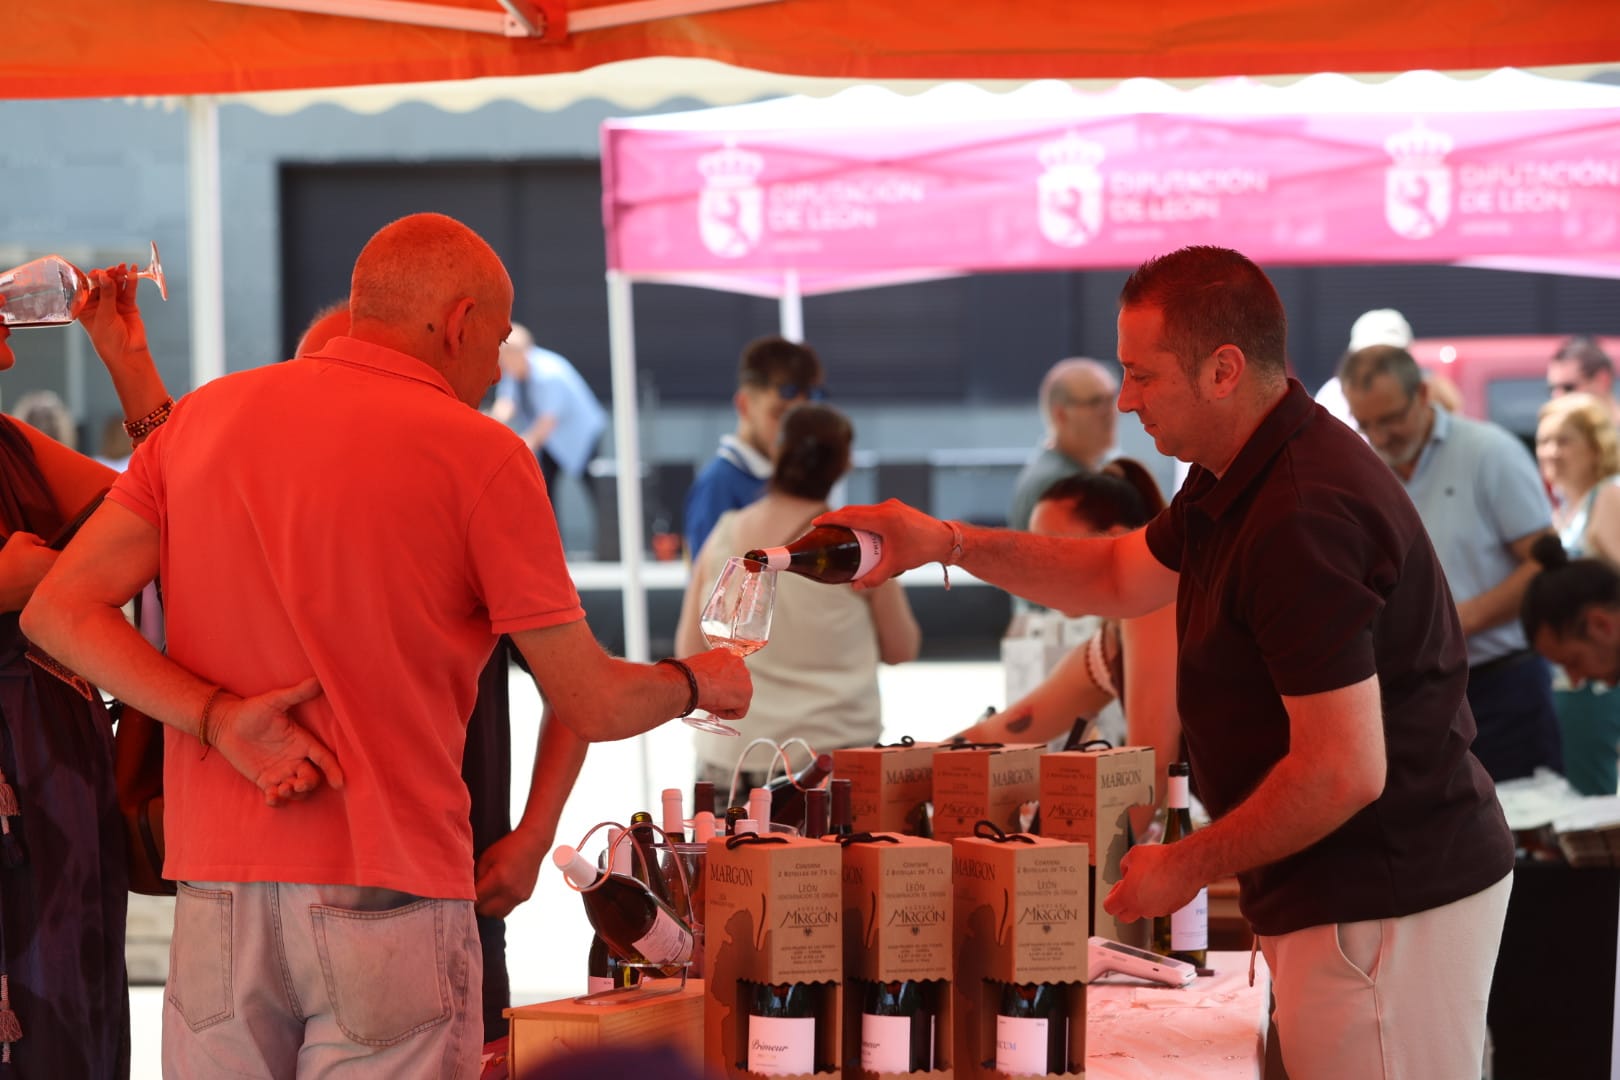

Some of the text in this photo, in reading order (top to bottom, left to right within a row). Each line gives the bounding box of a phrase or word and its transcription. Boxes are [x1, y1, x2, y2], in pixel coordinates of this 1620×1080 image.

[1110, 167, 1269, 195] DIPUTACIÓN
[1459, 157, 1618, 188] DIPUTACIÓN
[1109, 194, 1221, 224] DE LEÓN
[1459, 185, 1570, 214] DE LEÓN
[992, 767, 1034, 788] MARGON
[1100, 768, 1142, 790] MARGON
[710, 863, 753, 887] MARGON
[953, 857, 996, 881] MARGON
[752, 1038, 790, 1052] Primeur
